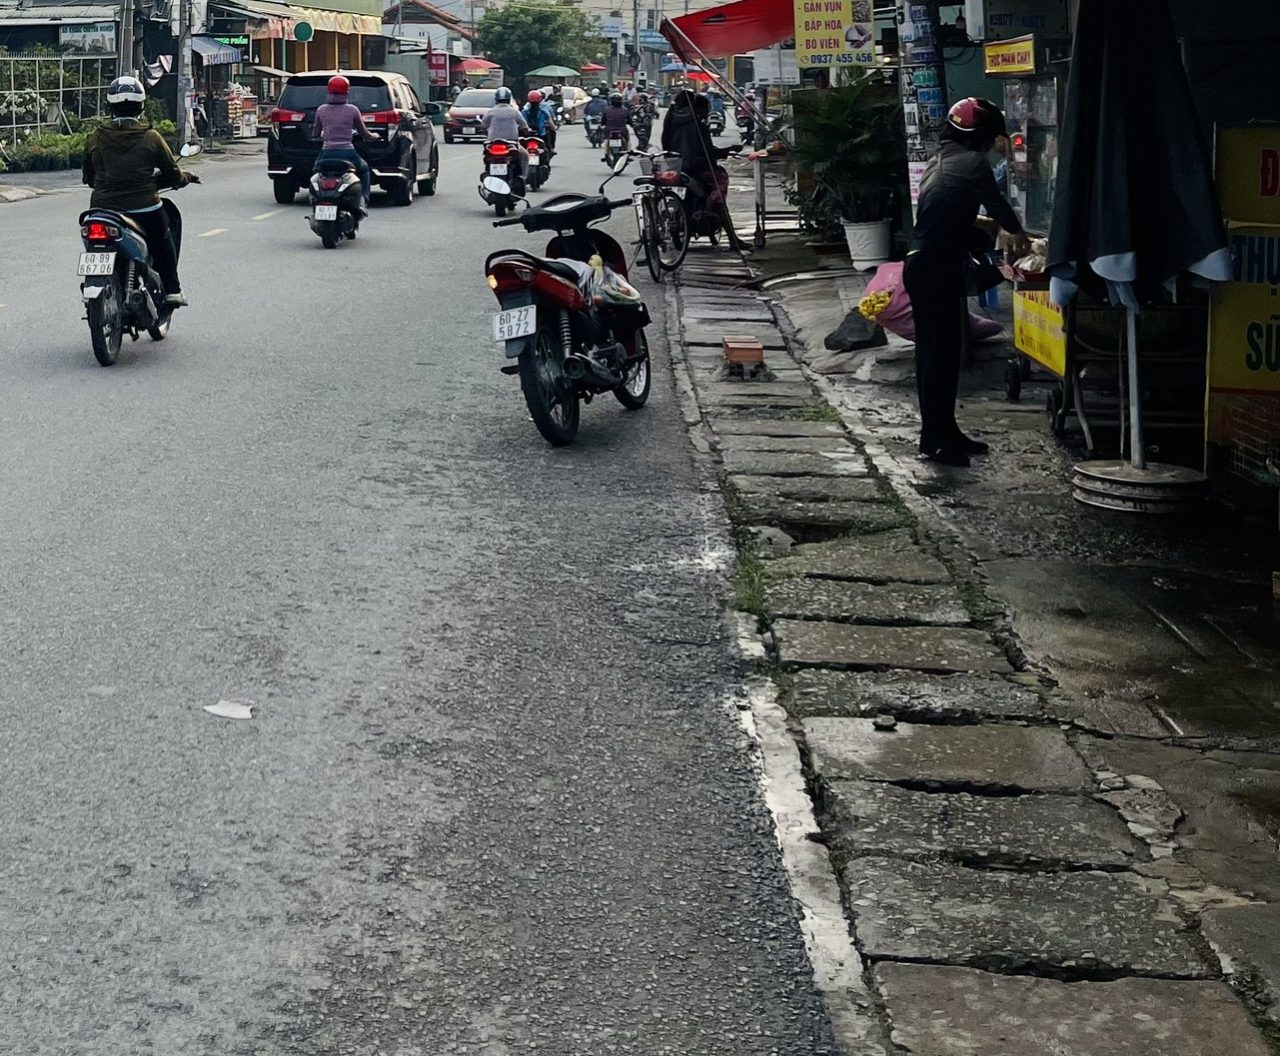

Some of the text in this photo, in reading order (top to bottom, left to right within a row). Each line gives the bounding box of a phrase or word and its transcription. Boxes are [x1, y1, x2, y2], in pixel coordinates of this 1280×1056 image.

[810, 52, 873, 64] 0937 455 456
[499, 321, 530, 339] 5872
